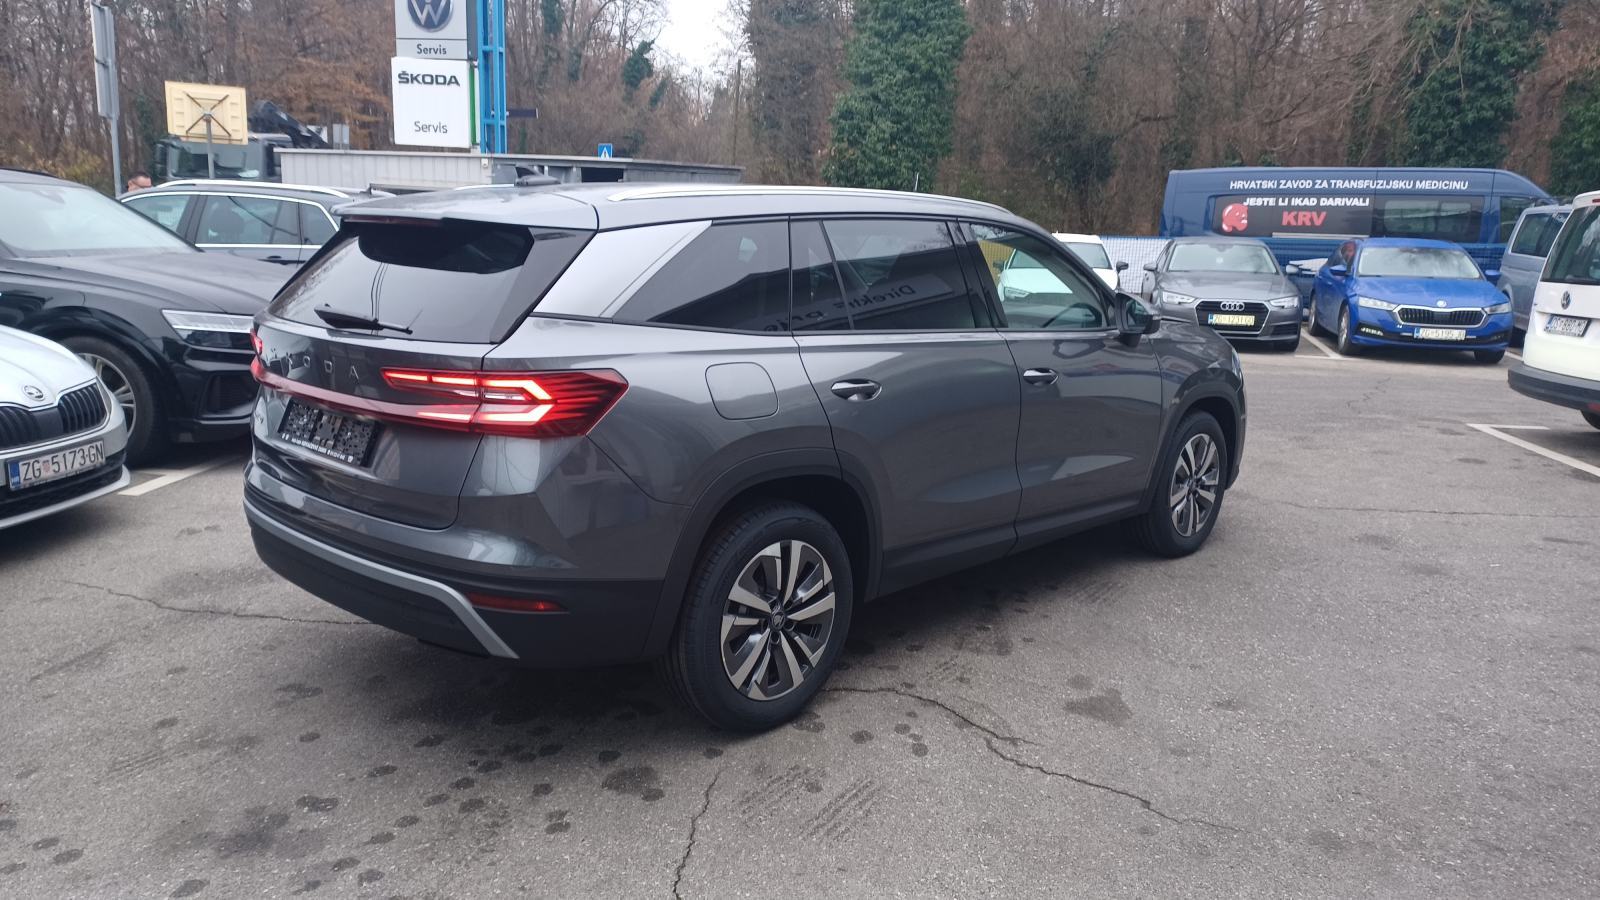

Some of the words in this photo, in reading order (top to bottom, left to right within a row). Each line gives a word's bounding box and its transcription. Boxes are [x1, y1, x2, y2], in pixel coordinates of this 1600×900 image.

[416, 43, 447, 55] Servis
[397, 70, 461, 87] ŠKODA
[414, 120, 448, 134] Servis
[1229, 180, 1277, 190] HRVATSKI
[1279, 180, 1313, 189] ZAVOD
[1315, 179, 1328, 189] ZA
[1330, 179, 1414, 189] TRANSFUZIJSKU
[1415, 180, 1468, 190] MEDICINU
[1243, 197, 1276, 206] JESTE
[1278, 197, 1289, 206] LI
[1291, 197, 1317, 206] IKAD
[1320, 197, 1369, 206] DARIVALI
[1281, 210, 1327, 226] KRV
[22, 460, 42, 481] ZG
